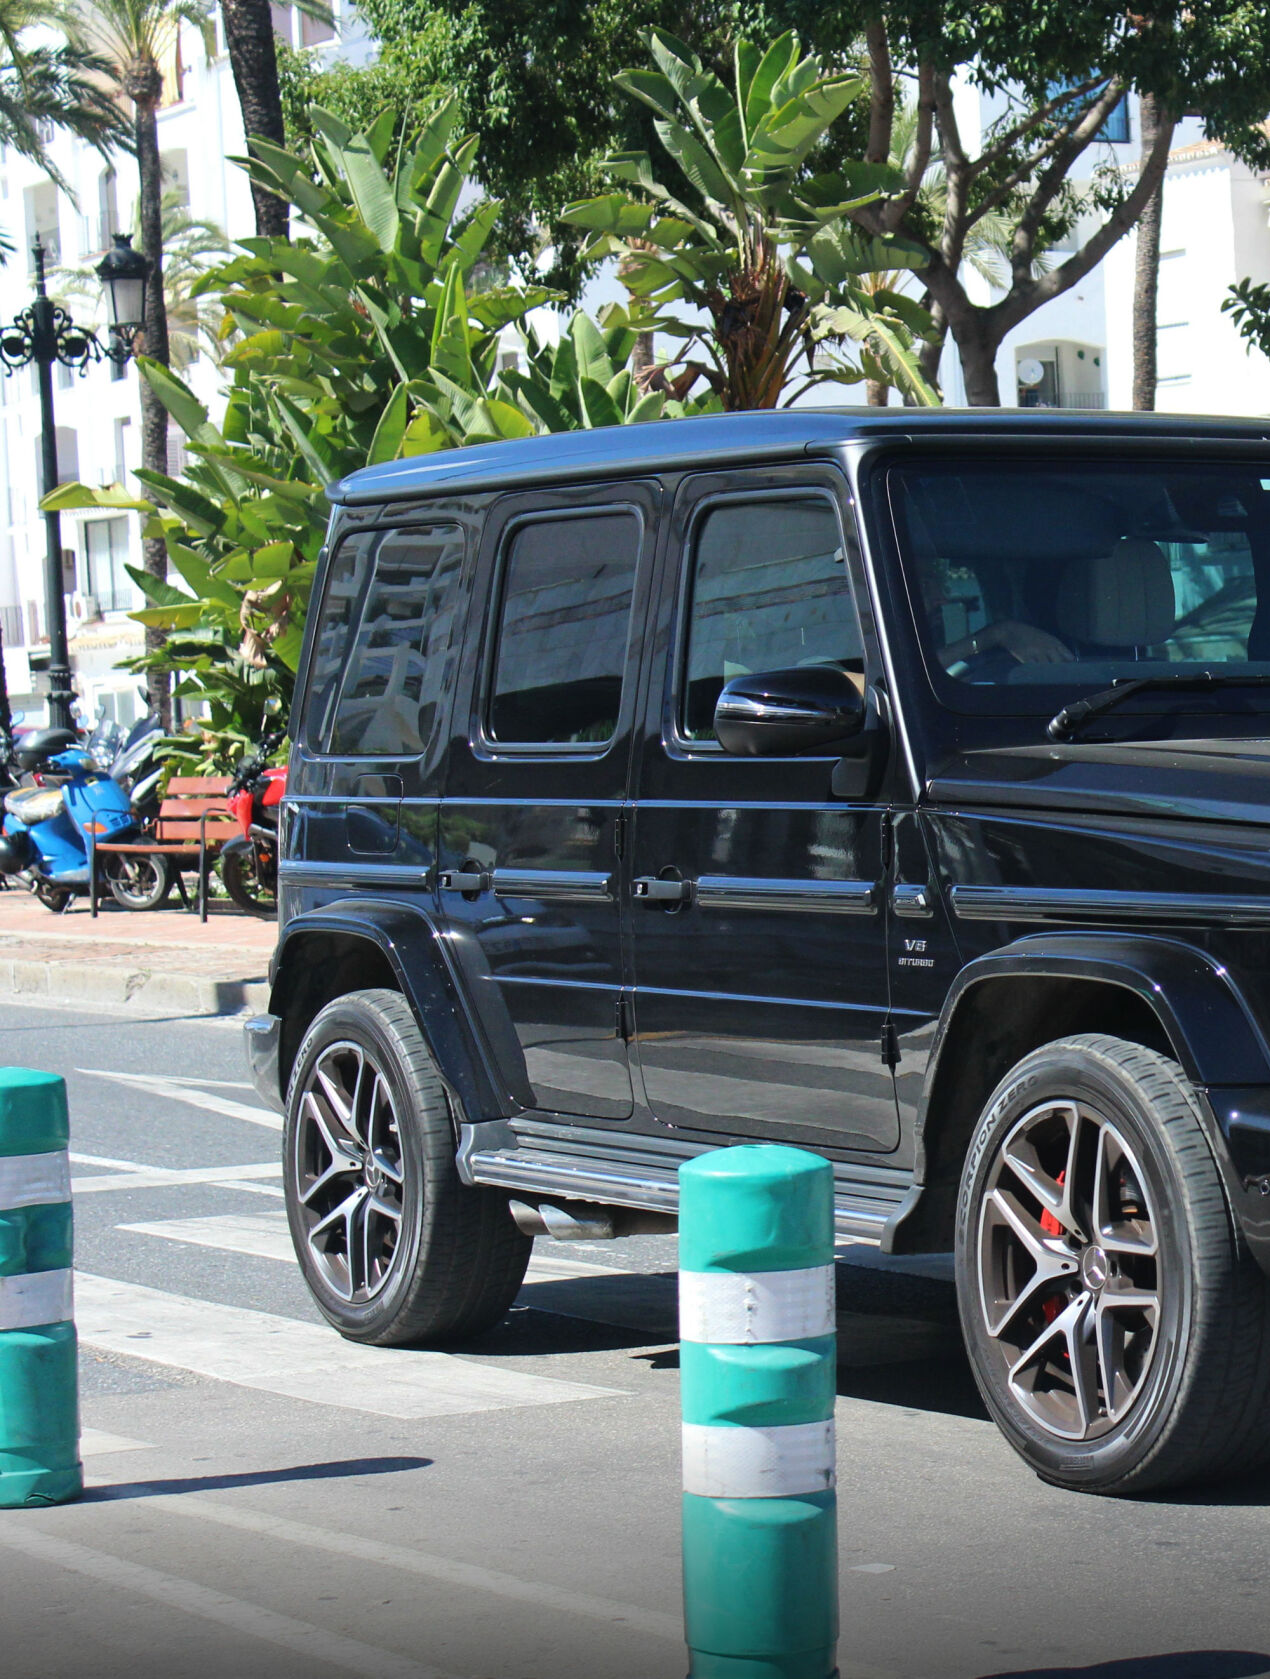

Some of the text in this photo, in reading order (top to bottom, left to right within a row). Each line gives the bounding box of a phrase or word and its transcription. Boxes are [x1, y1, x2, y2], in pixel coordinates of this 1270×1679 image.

[904, 939, 927, 952] V8
[898, 957, 934, 967] BITURBO
[998, 1074, 1040, 1114] ZERO
[958, 1114, 998, 1246] SCORPION
